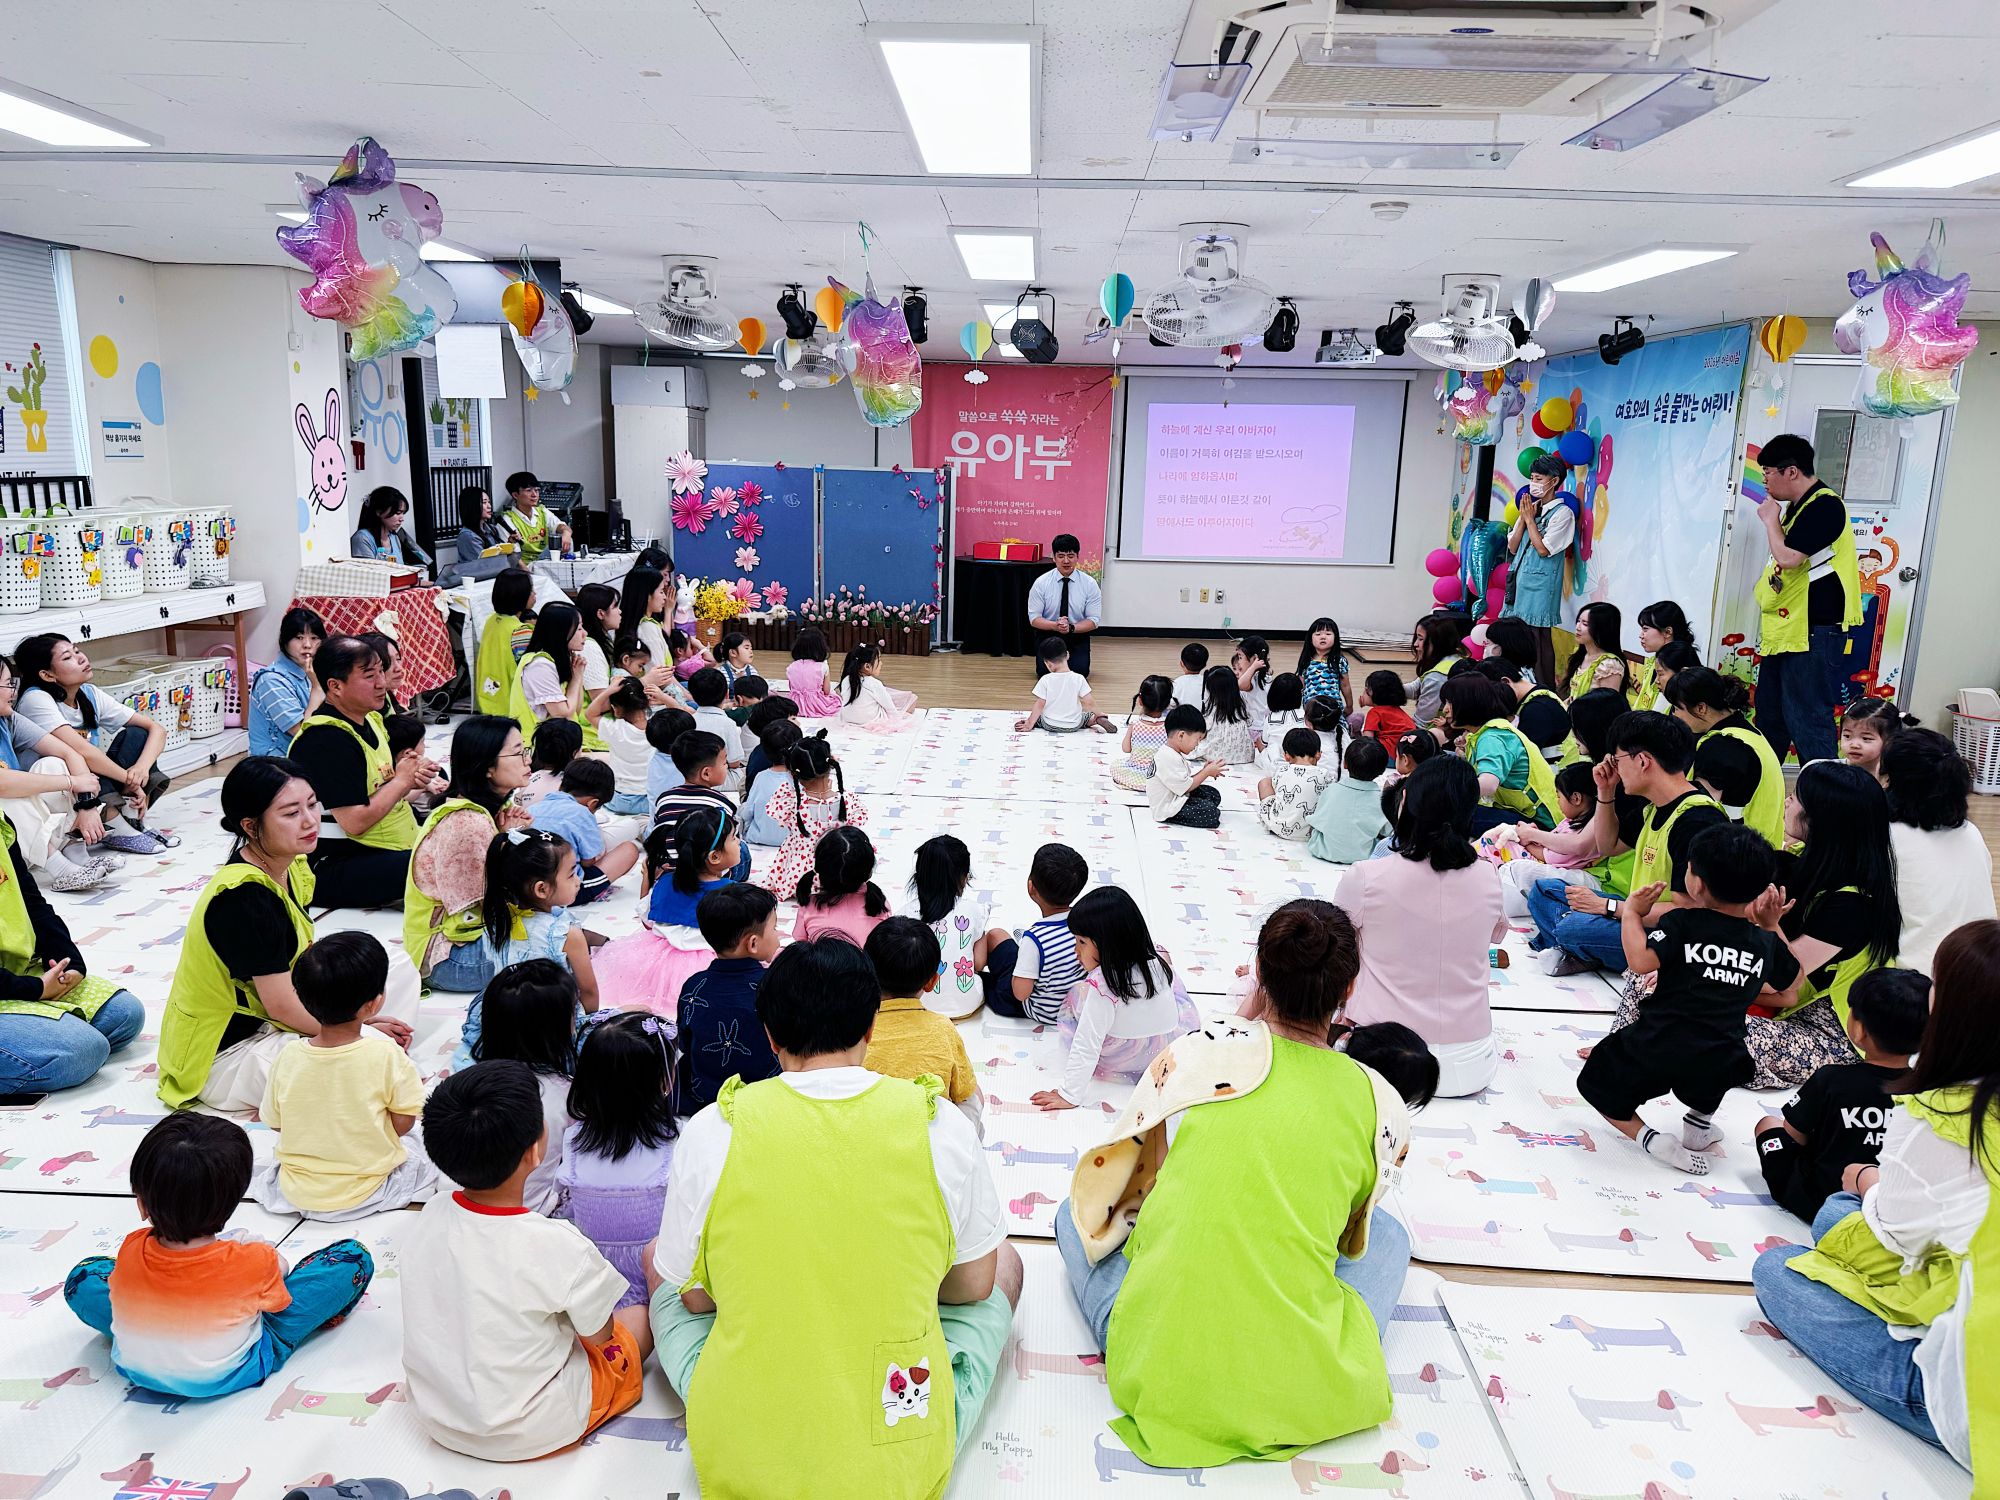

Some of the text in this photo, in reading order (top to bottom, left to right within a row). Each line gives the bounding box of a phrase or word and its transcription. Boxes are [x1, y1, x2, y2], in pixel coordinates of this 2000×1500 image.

[1615, 398, 1650, 420] 여호와의
[1653, 391, 1670, 424] 손을
[1669, 392, 1700, 424] 붙잡는
[958, 409, 1060, 426] 말씀으로 쑥쑥 자라는
[1161, 424, 1190, 436] 하늘에
[1193, 425, 1212, 436] 계신
[1215, 425, 1235, 436] 우리
[944, 430, 1072, 481] 유아부
[1160, 448, 1188, 459] 이름이
[1191, 448, 1220, 459] 거룩히
[1223, 448, 1252, 460] 여김을
[1190, 471, 1238, 481] 임하옵시며
[1157, 494, 1176, 505] 뜻이
[1179, 494, 1217, 505] 하늘에서
[1252, 495, 1272, 505] 같이
[1156, 516, 1195, 528] 땅에서도
[1684, 943, 1764, 979] KOREA
[1702, 967, 1749, 987] ARMY
[995, 1431, 1020, 1442] Hello
[982, 1441, 1033, 1458] My Puppy
